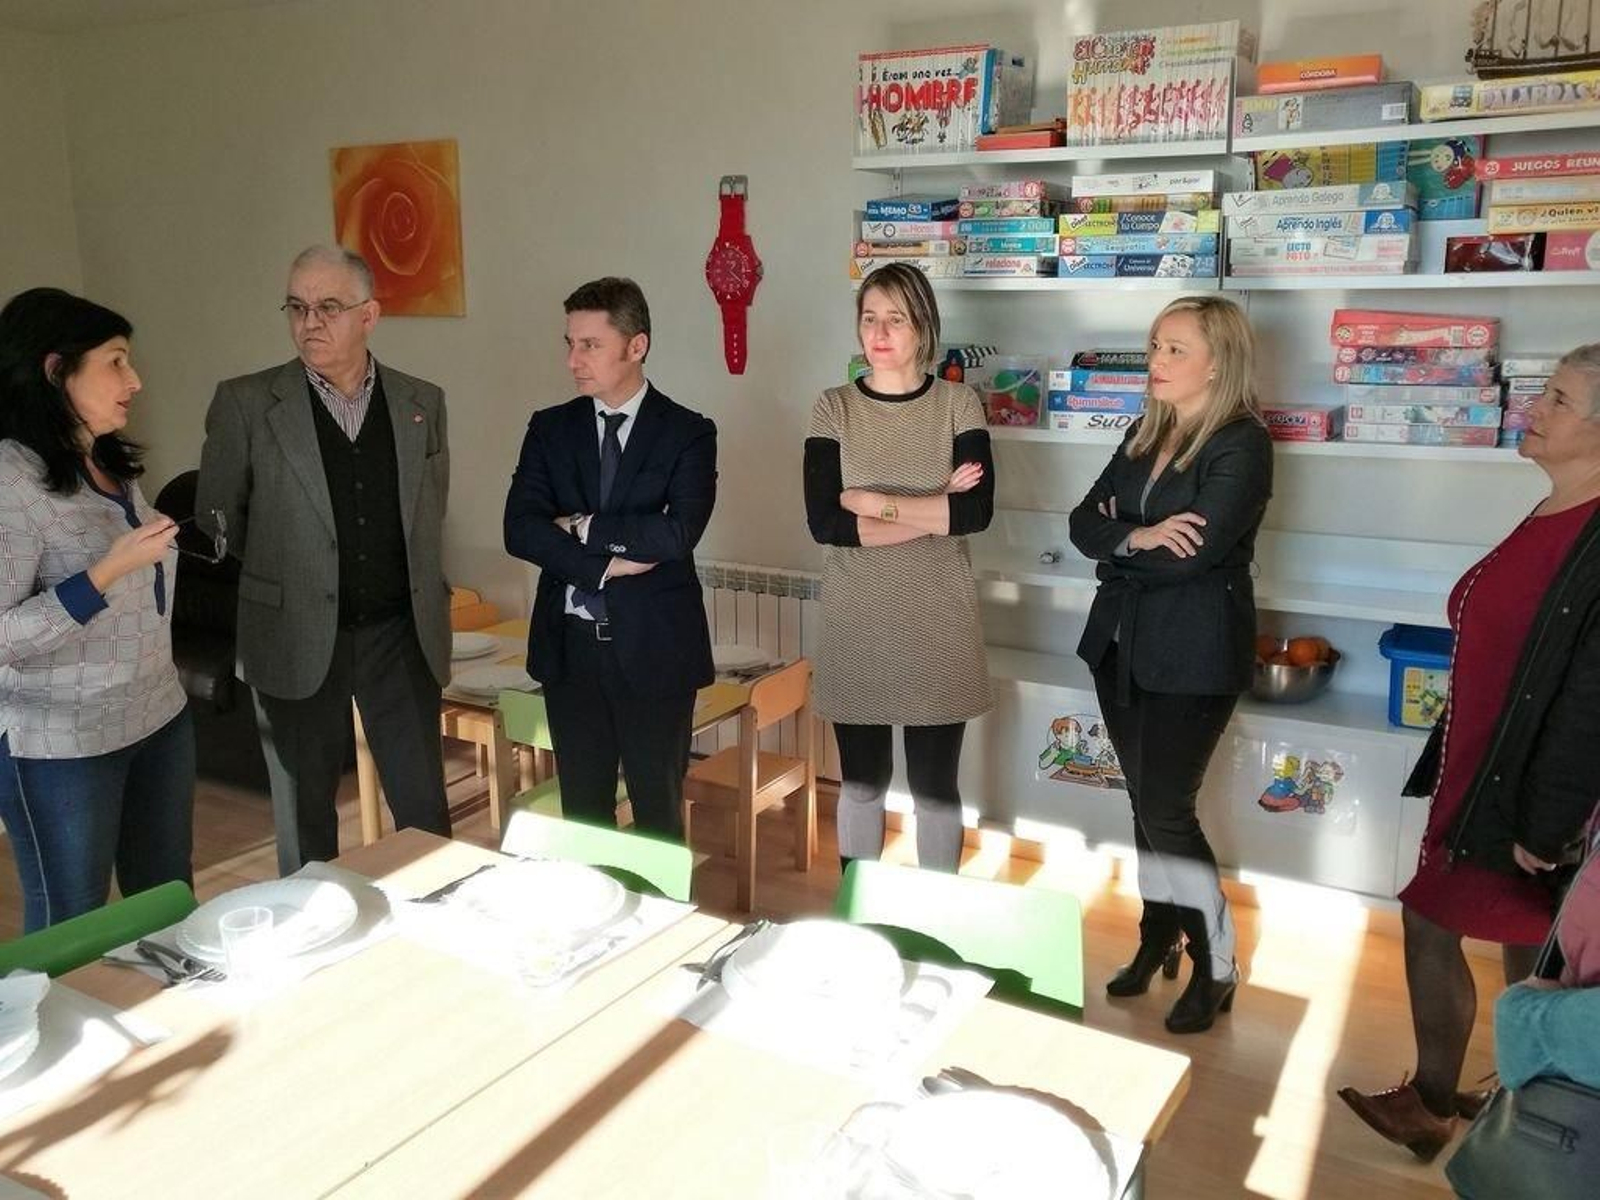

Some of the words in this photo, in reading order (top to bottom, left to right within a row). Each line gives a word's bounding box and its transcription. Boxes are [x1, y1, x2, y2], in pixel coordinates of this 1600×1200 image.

[867, 77, 978, 112] HOMBRE
[1512, 160, 1561, 171] JUEGOS
[1311, 191, 1345, 204] Galego
[1125, 213, 1156, 222] Conoce
[1276, 217, 1315, 231] Aprendo
[1315, 216, 1343, 231] Inglés
[1130, 222, 1160, 232] Cuerpo
